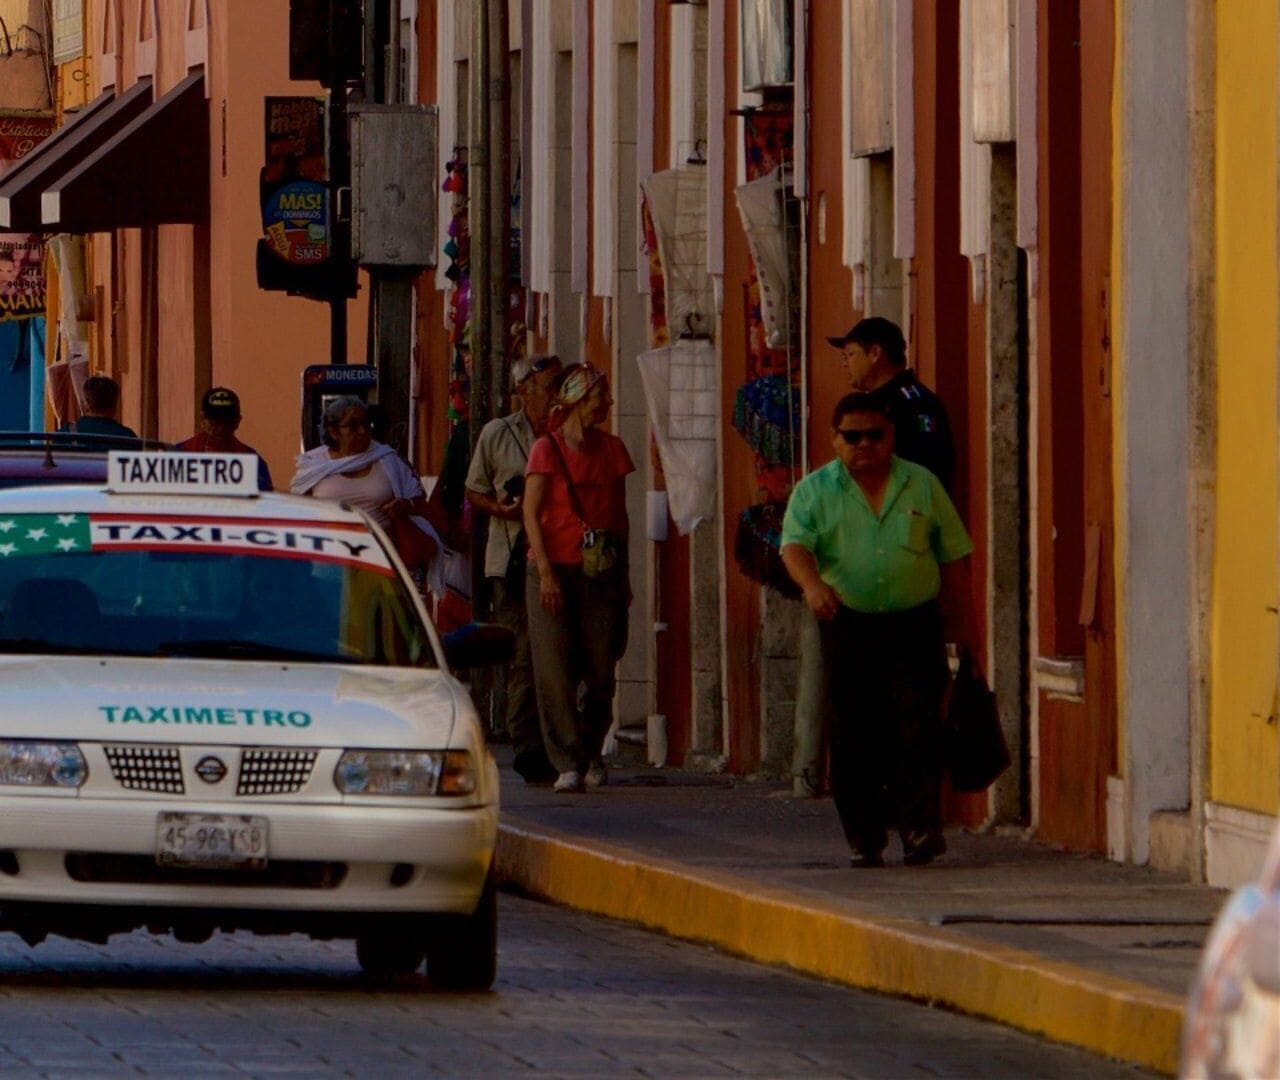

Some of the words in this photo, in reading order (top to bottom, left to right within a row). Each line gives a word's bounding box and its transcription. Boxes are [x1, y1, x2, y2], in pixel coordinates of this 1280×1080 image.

[294, 248, 322, 260] SMS
[117, 454, 244, 485] TAXIMETRO
[96, 523, 373, 557] TAXI-CITY
[99, 705, 312, 729] TAXIMETRO
